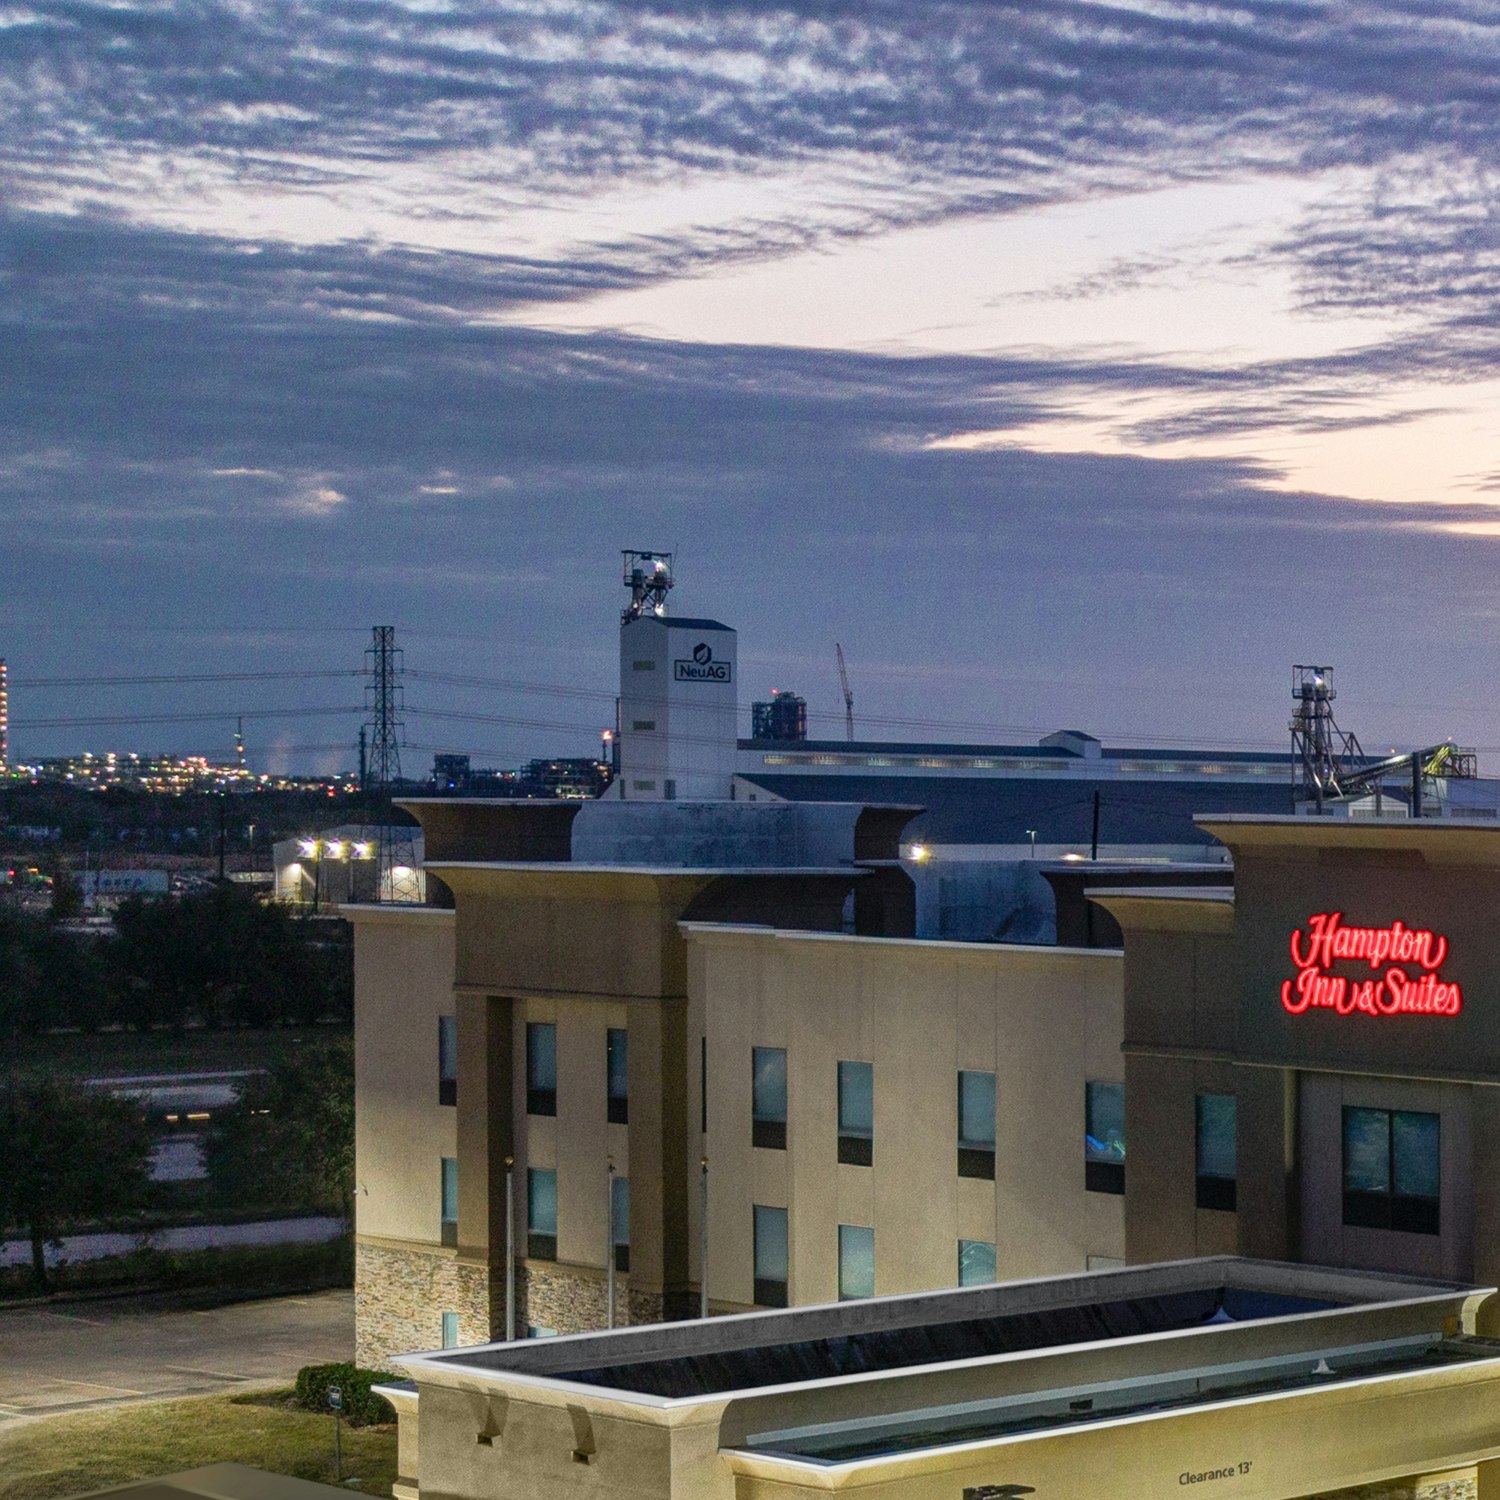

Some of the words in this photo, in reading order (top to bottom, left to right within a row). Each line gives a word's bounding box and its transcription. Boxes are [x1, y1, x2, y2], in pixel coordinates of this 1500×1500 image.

[680, 664, 727, 679] NeuAG
[1290, 911, 1448, 970] Hampton
[1281, 965, 1359, 1015] Inn
[1356, 979, 1379, 1016] &
[1375, 967, 1463, 1016] Suites
[1178, 1467, 1235, 1485] Clearance
[1237, 1460, 1253, 1475] 13'
